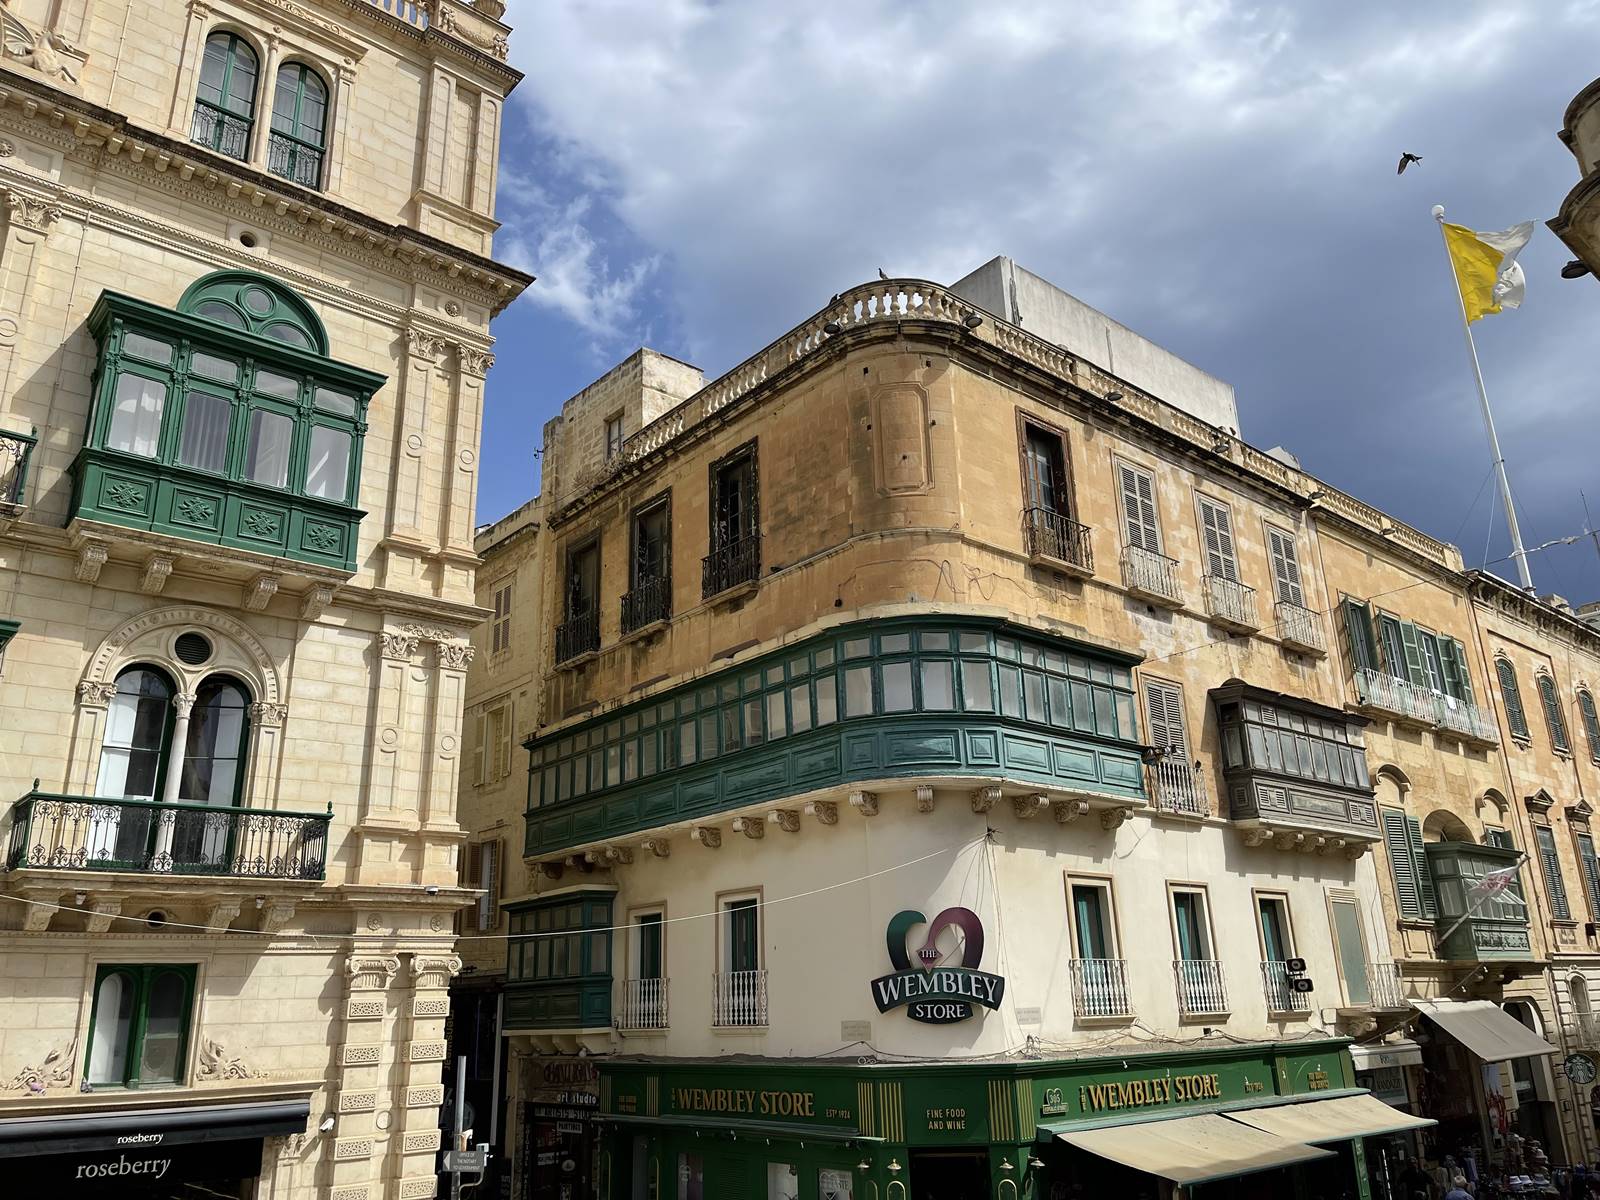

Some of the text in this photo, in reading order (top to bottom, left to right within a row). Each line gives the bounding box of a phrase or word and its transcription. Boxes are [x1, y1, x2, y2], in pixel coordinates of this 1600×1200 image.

[921, 949, 937, 958] THE
[878, 971, 998, 1005] WEMBLEY
[915, 1004, 965, 1019] STORE
[1088, 1077, 1171, 1110] WEMBLEY
[1174, 1074, 1222, 1102] STORE
[678, 1088, 756, 1113] WEMBLEY
[760, 1091, 815, 1117] STORE
[926, 1108, 965, 1119] FINE FOOD
[928, 1120, 966, 1130] AND WINE
[117, 1133, 164, 1145] roseberry
[75, 1154, 172, 1179] roseberry
